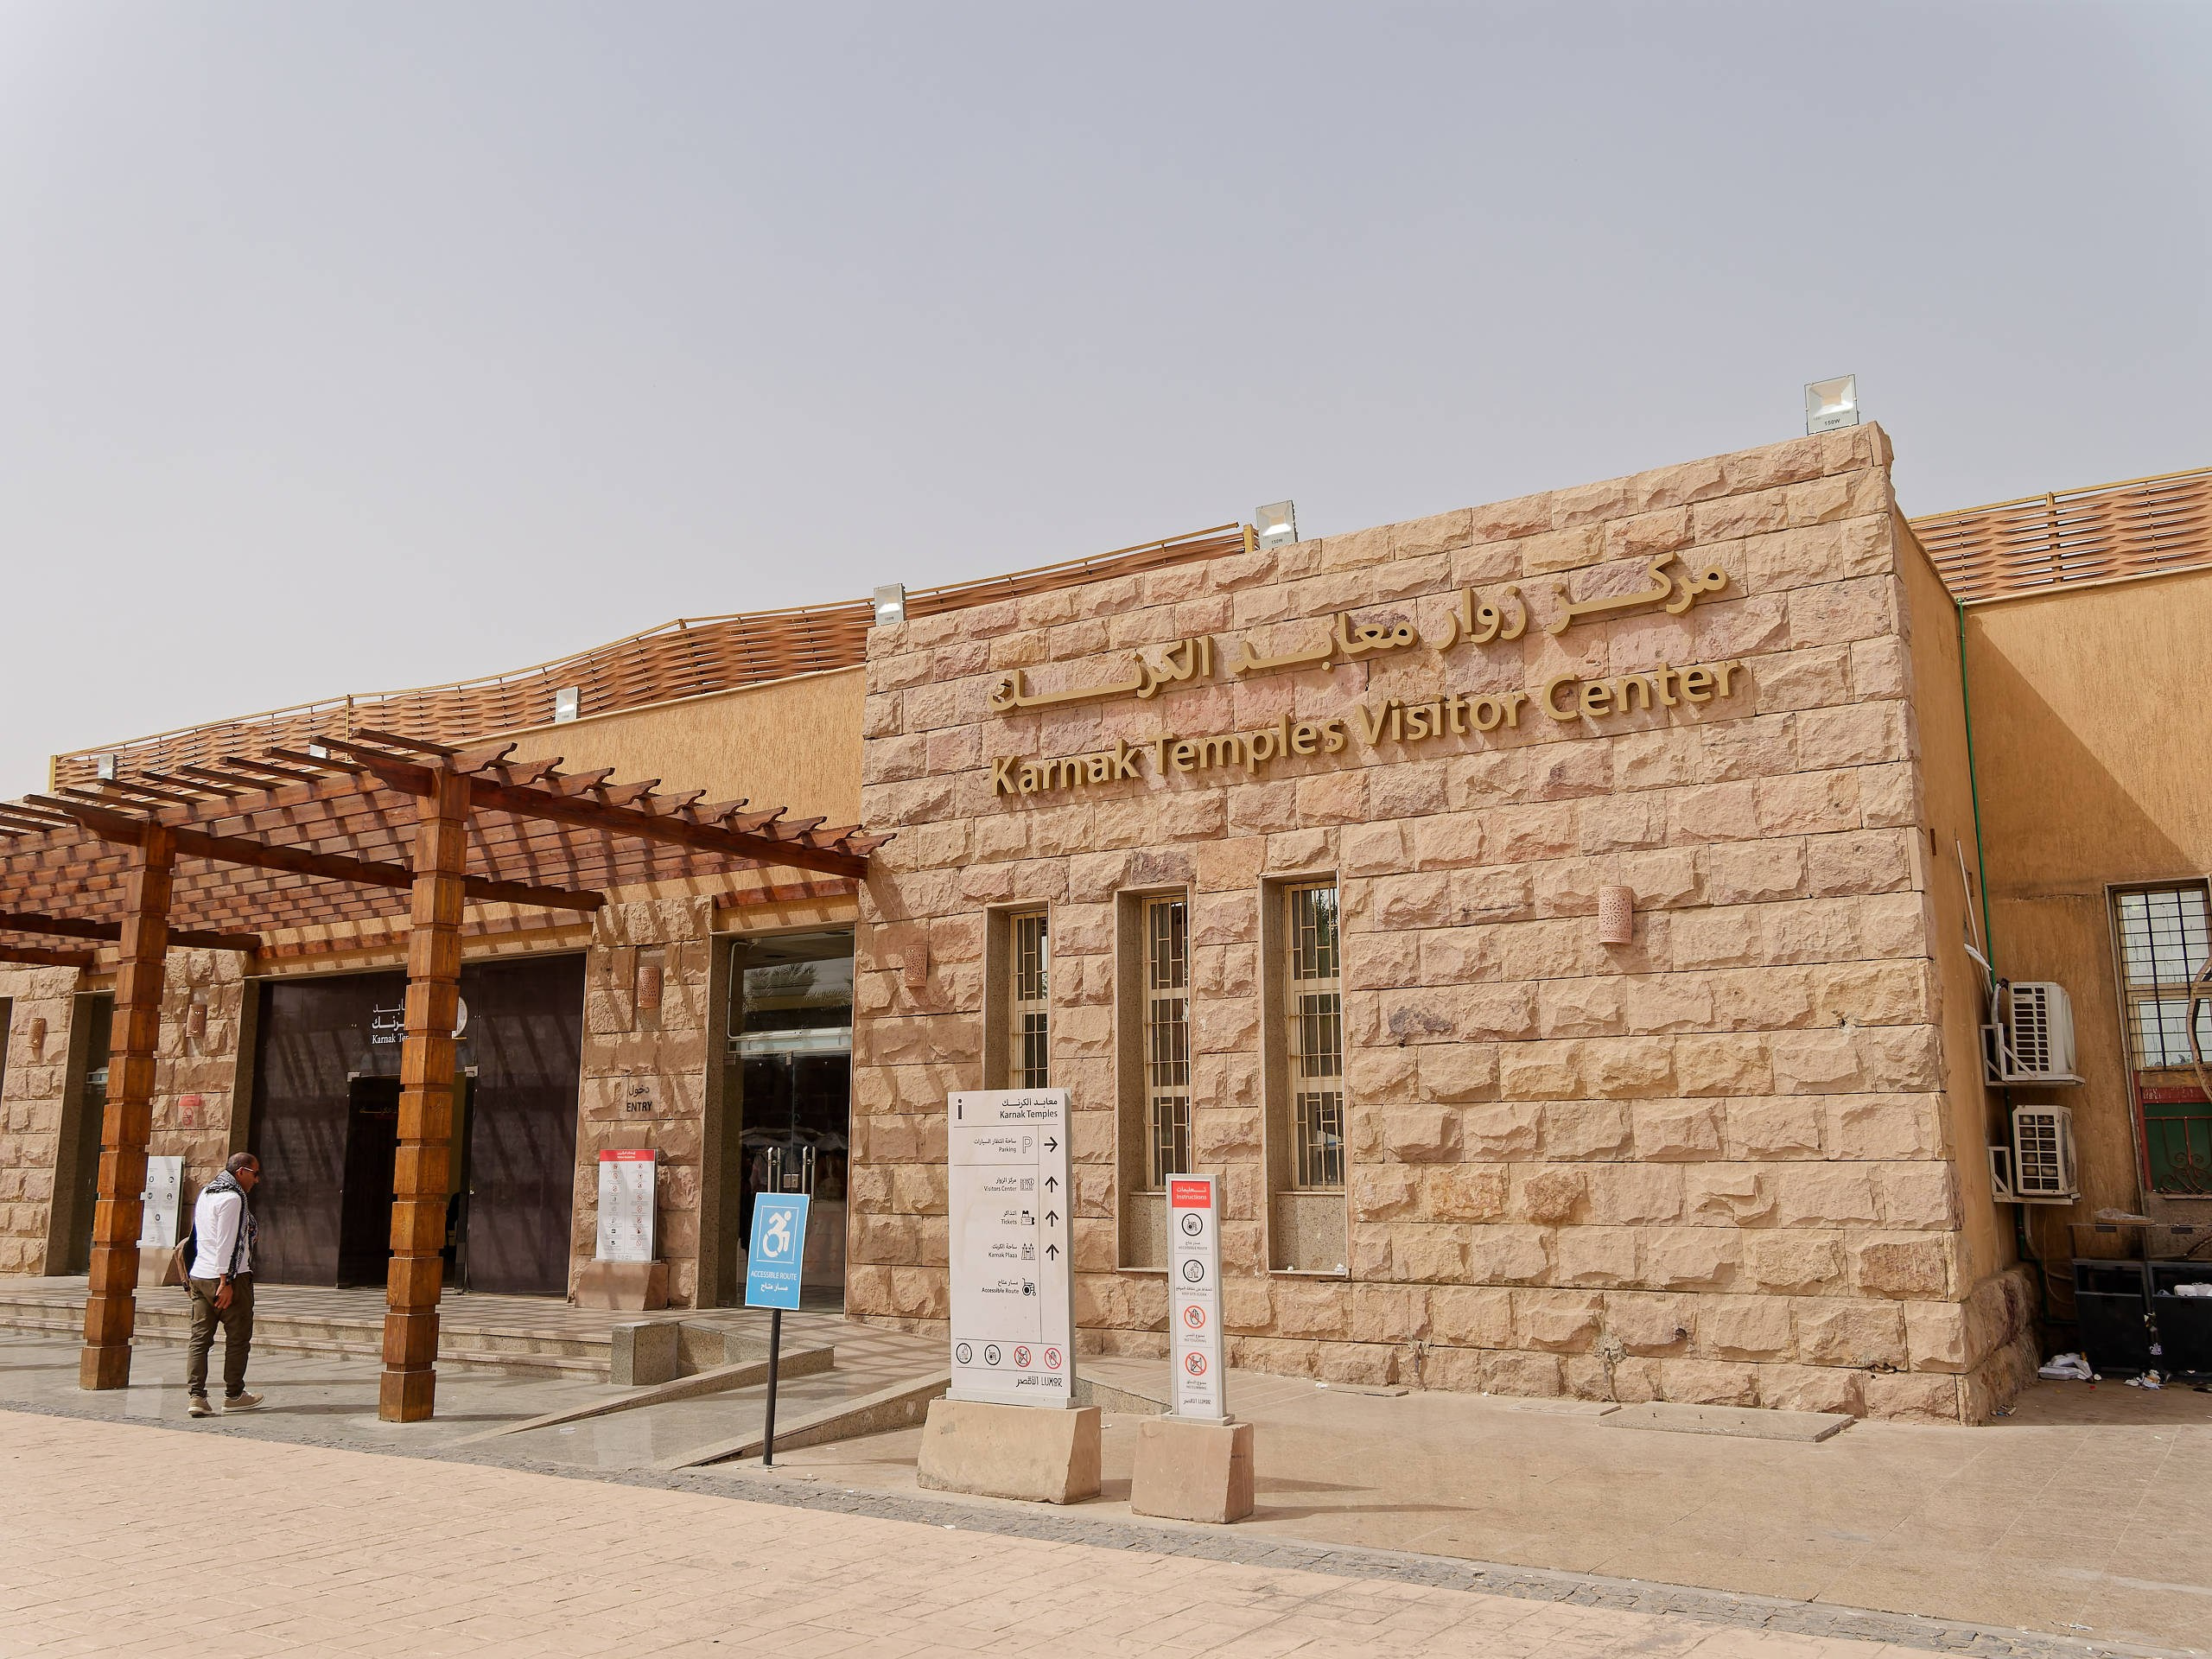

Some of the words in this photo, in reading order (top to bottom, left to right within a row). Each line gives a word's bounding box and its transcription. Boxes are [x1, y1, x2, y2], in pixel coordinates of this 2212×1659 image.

[1546, 550, 1728, 637] مركز
[1431, 585, 1528, 652] زوار
[1228, 612, 1419, 673] معابد
[987, 635, 1215, 712] الكرنك
[991, 738, 1145, 798] Karnak
[1147, 713, 1349, 776] Temples
[1355, 691, 1528, 747] Visitor
[1541, 659, 1741, 723] Center
[372, 1033, 396, 1045] Karnak
[628, 1084, 650, 1097] دخول
[626, 1101, 652, 1112] ENTRY
[1001, 1097, 1032, 1109] الكرنك
[1033, 1097, 1058, 1109] معابد
[1000, 1110, 1026, 1119] Karnak
[1027, 1109, 1058, 1119] Temples
[1176, 1185, 1207, 1194] تعليمات
[750, 1269, 779, 1279] ACCESSIBLE
[780, 1272, 798, 1281] ROUTE
[773, 1282, 789, 1293] مسار
